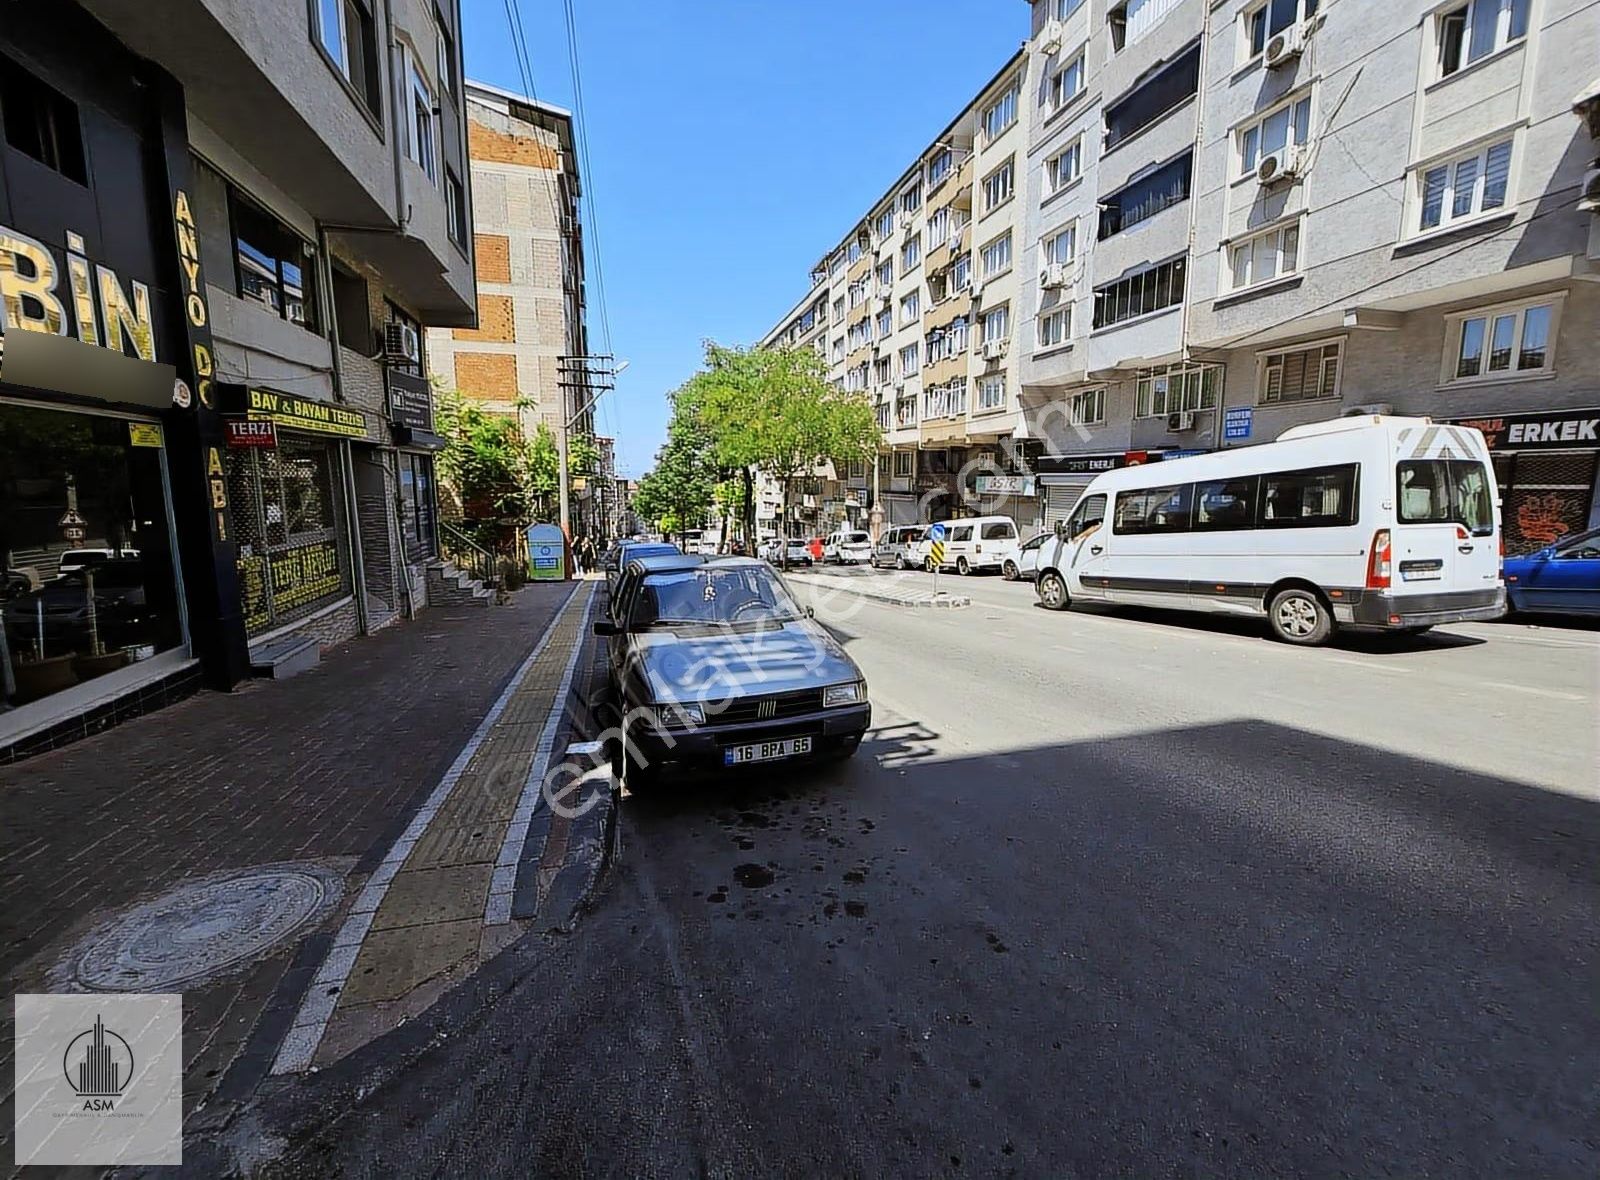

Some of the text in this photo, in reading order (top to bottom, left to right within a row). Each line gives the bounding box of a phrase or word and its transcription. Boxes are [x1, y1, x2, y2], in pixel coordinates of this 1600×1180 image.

[250, 390, 279, 411] BAY
[281, 400, 293, 414] &
[293, 399, 329, 421] BAYAN
[1508, 418, 1600, 443] ERKEK
[737, 746, 754, 761] 16
[793, 738, 809, 752] 65
